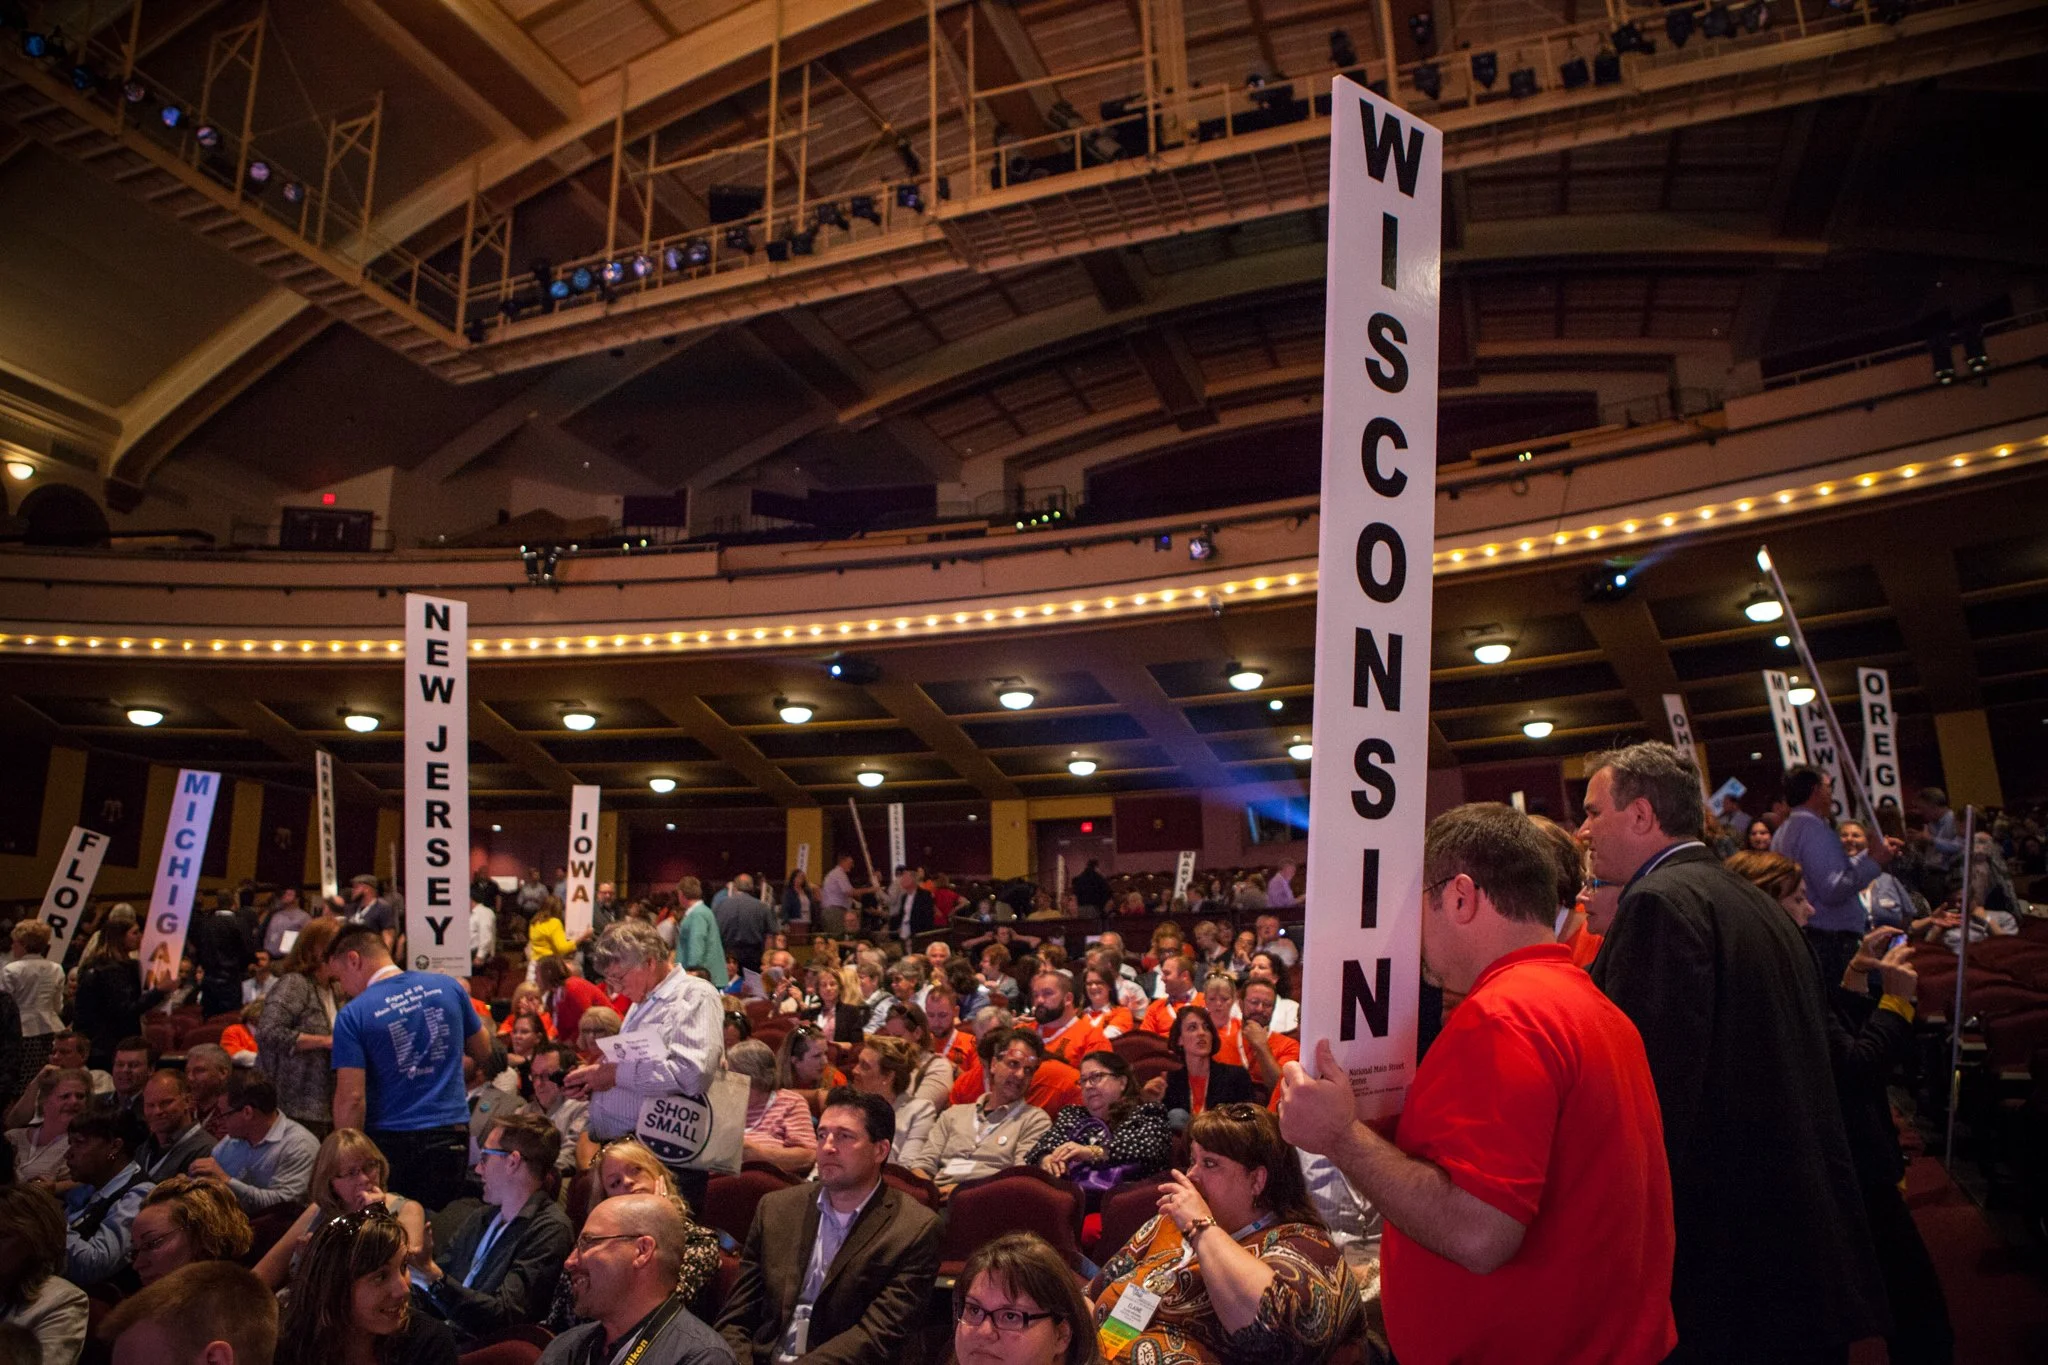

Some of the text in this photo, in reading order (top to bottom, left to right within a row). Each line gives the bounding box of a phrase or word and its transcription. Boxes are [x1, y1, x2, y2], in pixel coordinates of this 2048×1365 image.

[1340, 97, 1425, 1042] WISCONSIN
[419, 602, 456, 704] NEW
[1771, 674, 1800, 757] MINN
[1807, 701, 1834, 765] NEW
[425, 724, 454, 946] JERSEY
[570, 812, 595, 903] IOWA
[46, 831, 101, 940] FLOR
[653, 1099, 700, 1125] SHOP
[1349, 1066, 1374, 1076] National
[1373, 1064, 1388, 1073] Main
[644, 1112, 698, 1144] SMALL
